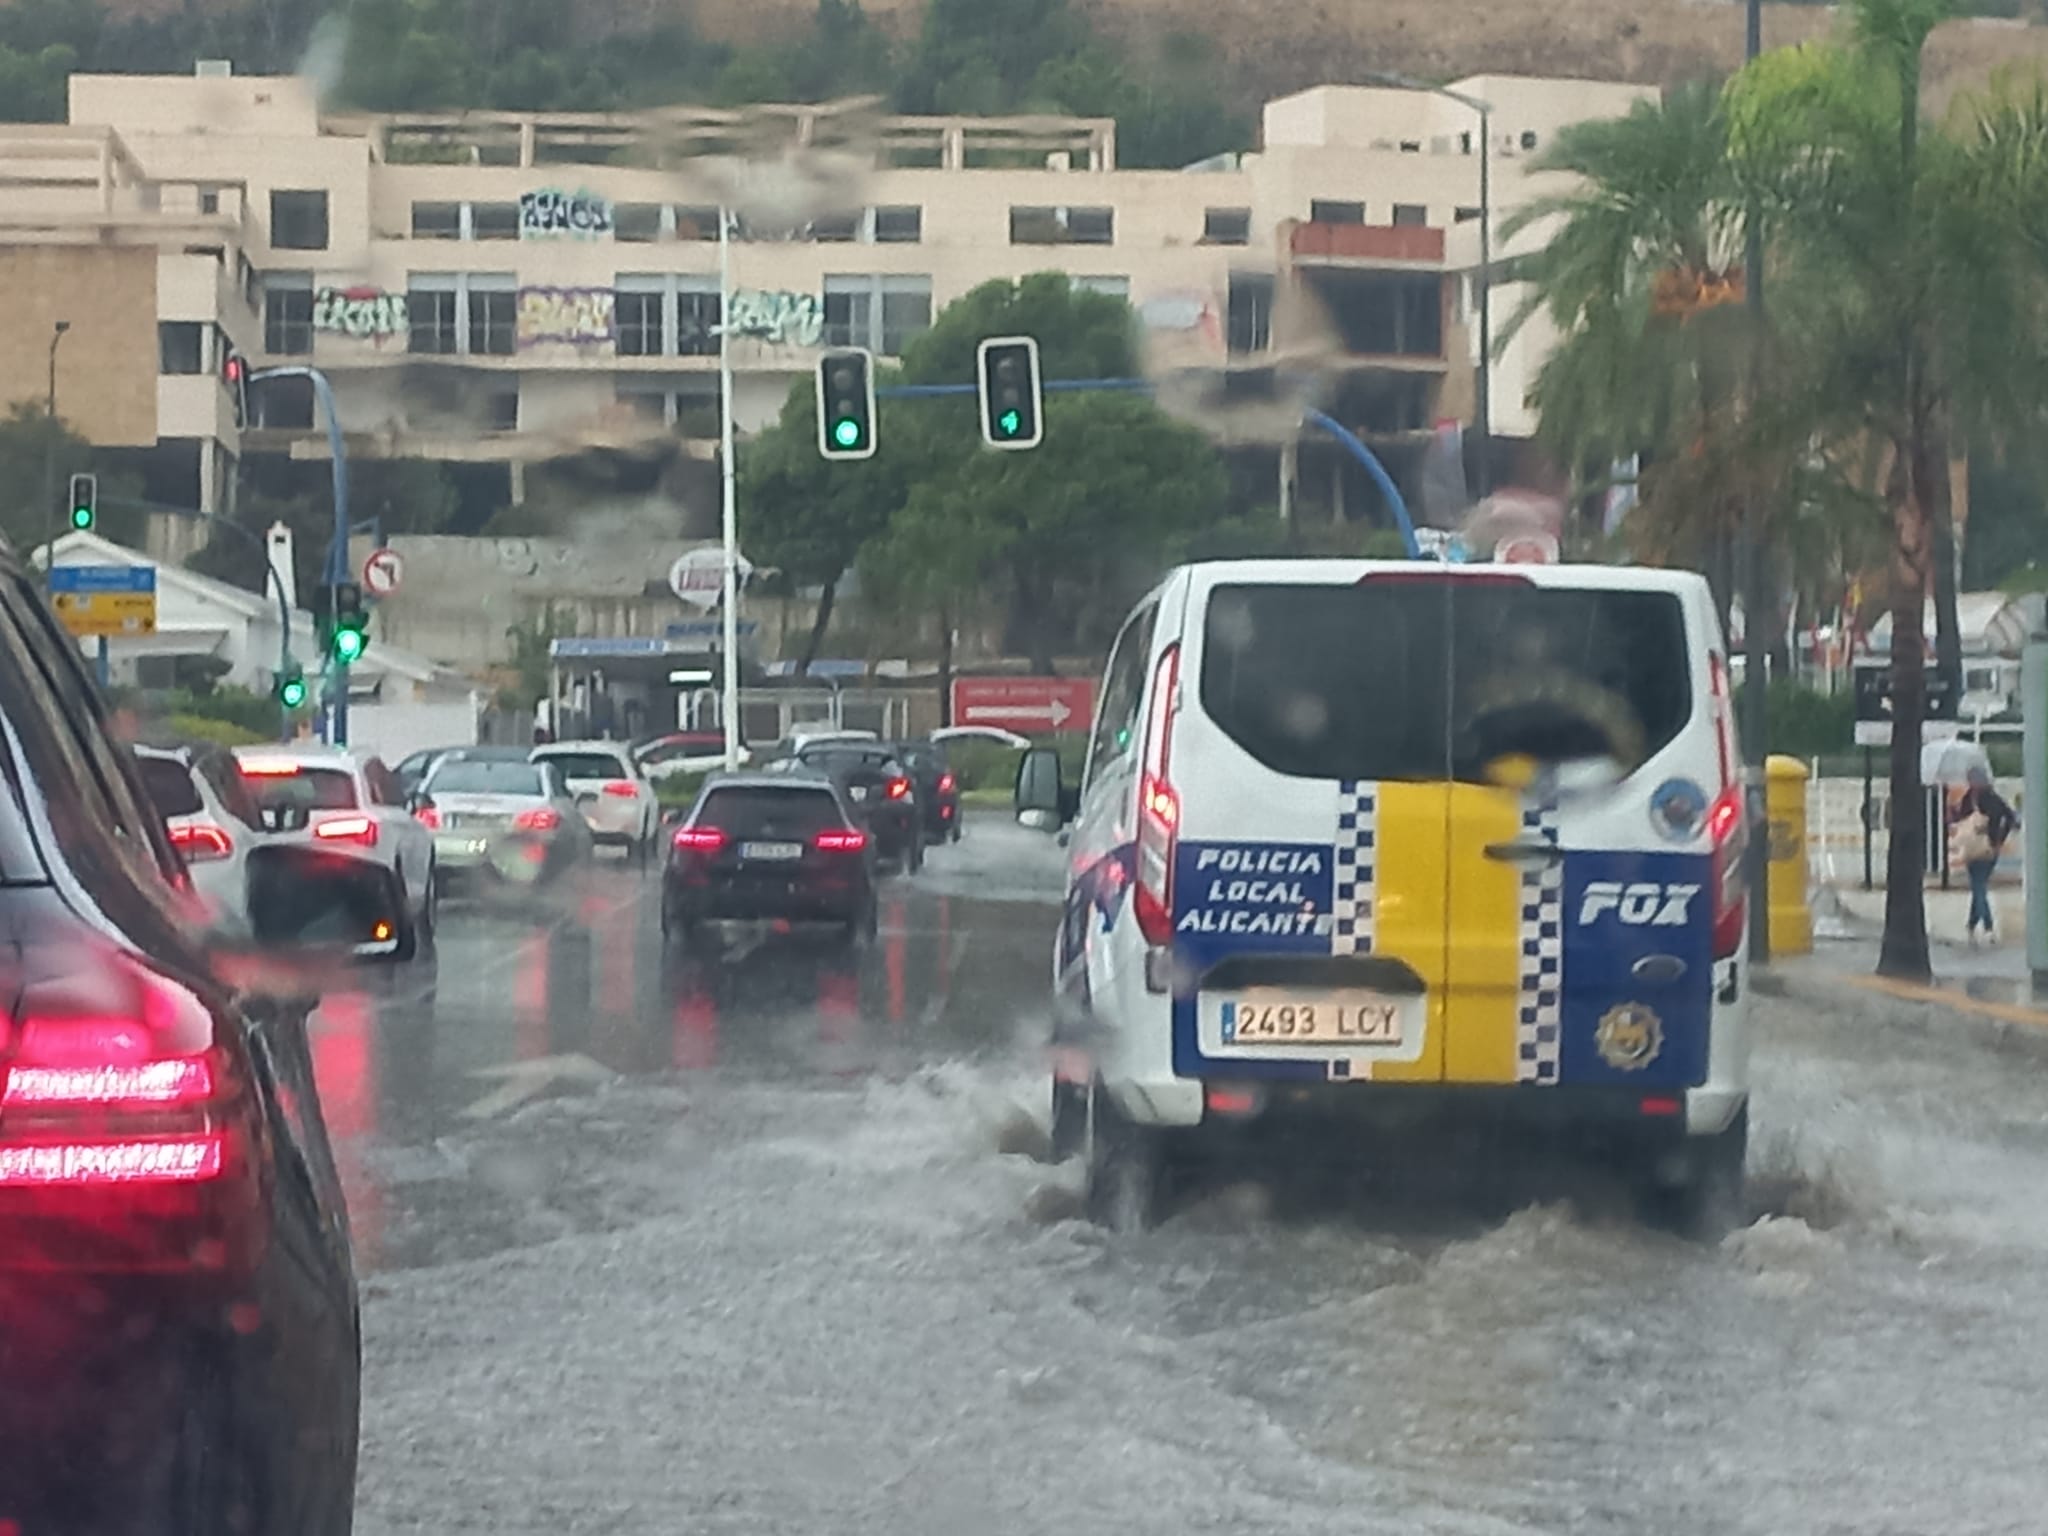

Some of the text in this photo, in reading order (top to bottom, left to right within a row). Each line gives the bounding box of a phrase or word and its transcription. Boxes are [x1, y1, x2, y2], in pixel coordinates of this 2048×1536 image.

[1196, 849, 1321, 875] POLICIA
[1208, 879, 1306, 904] LOCAL
[1578, 882, 1701, 926] FOX
[1239, 1005, 1397, 1035] 2493 LCY
